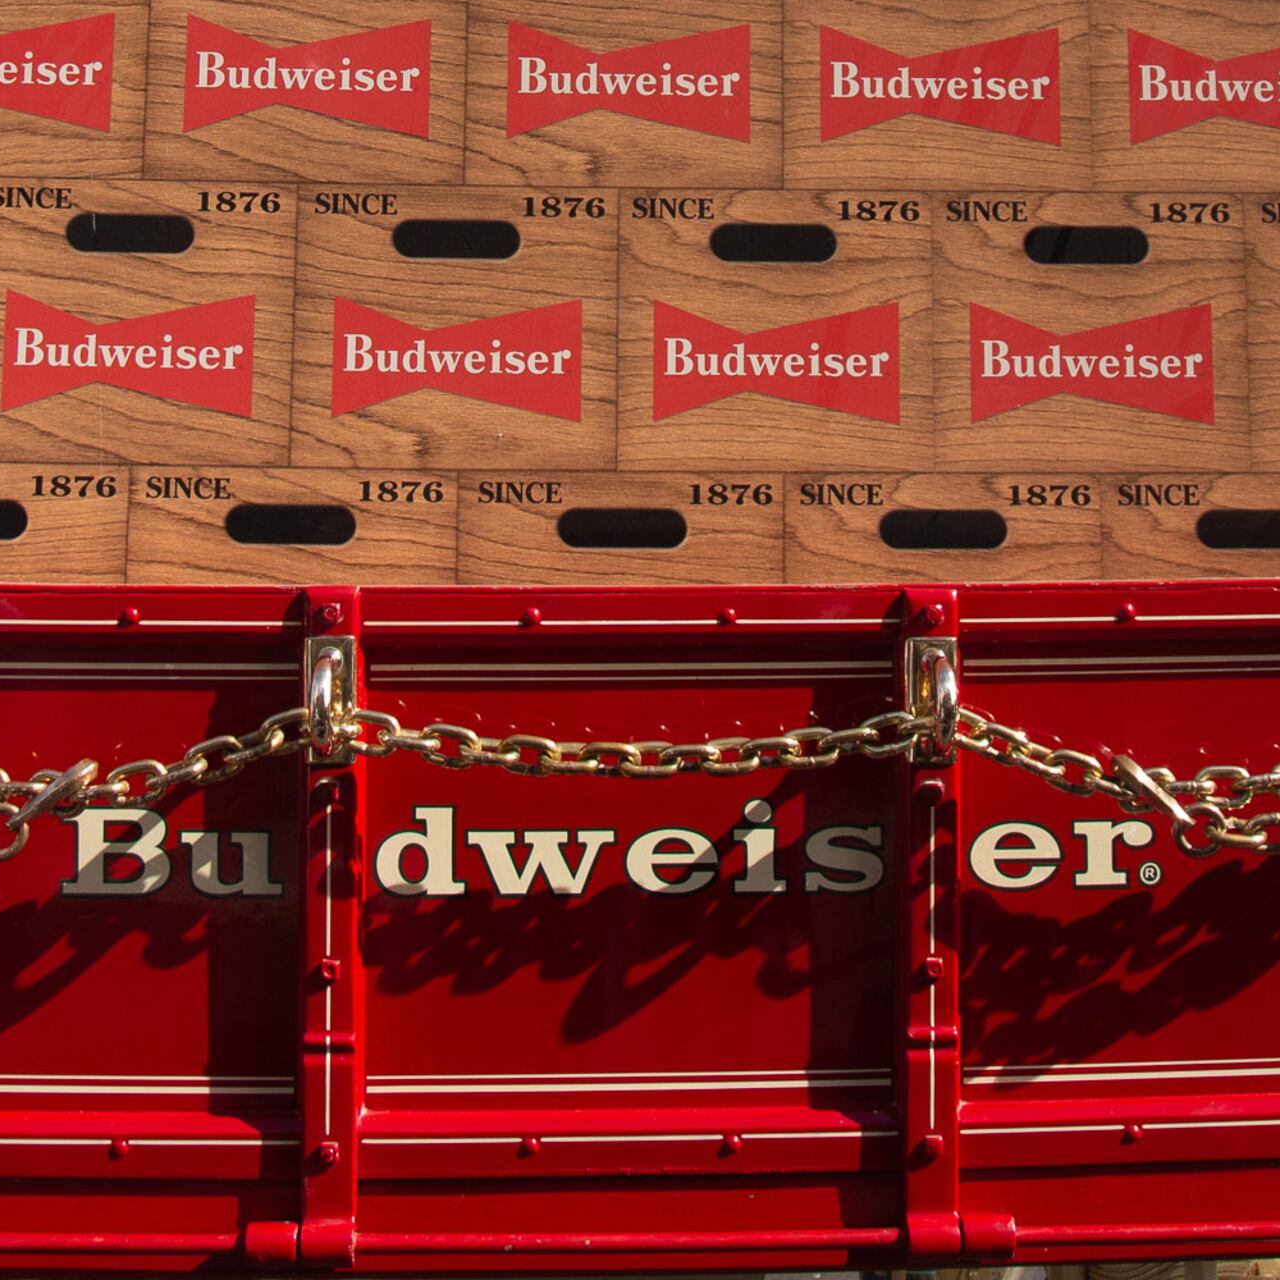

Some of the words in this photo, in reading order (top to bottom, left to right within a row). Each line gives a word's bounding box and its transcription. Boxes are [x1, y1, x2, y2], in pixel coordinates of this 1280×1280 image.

[195, 51, 420, 92] Budweiser
[517, 56, 741, 97] Budweiser
[830, 61, 1050, 101] Budweiser
[197, 191, 281, 214] 1876
[314, 193, 397, 215] SINCE
[522, 195, 606, 219] 1876
[631, 196, 715, 220] SINCE
[838, 200, 920, 223] 1876
[944, 199, 1028, 223] SINCE
[1149, 201, 1231, 225] 1876
[13, 327, 244, 370] Budweiser
[343, 333, 572, 375] Budweiser
[663, 337, 890, 378] Budweiser
[980, 339, 1203, 379] Budweiser
[31, 475, 117, 498] 1876
[145, 476, 232, 500] SINCE
[359, 480, 444, 503] 1876
[477, 481, 563, 505] SINCE
[689, 482, 773, 506] 1876
[799, 482, 884, 506] SINCE
[1008, 484, 1092, 507] 1876
[1115, 483, 1200, 507] SINCE
